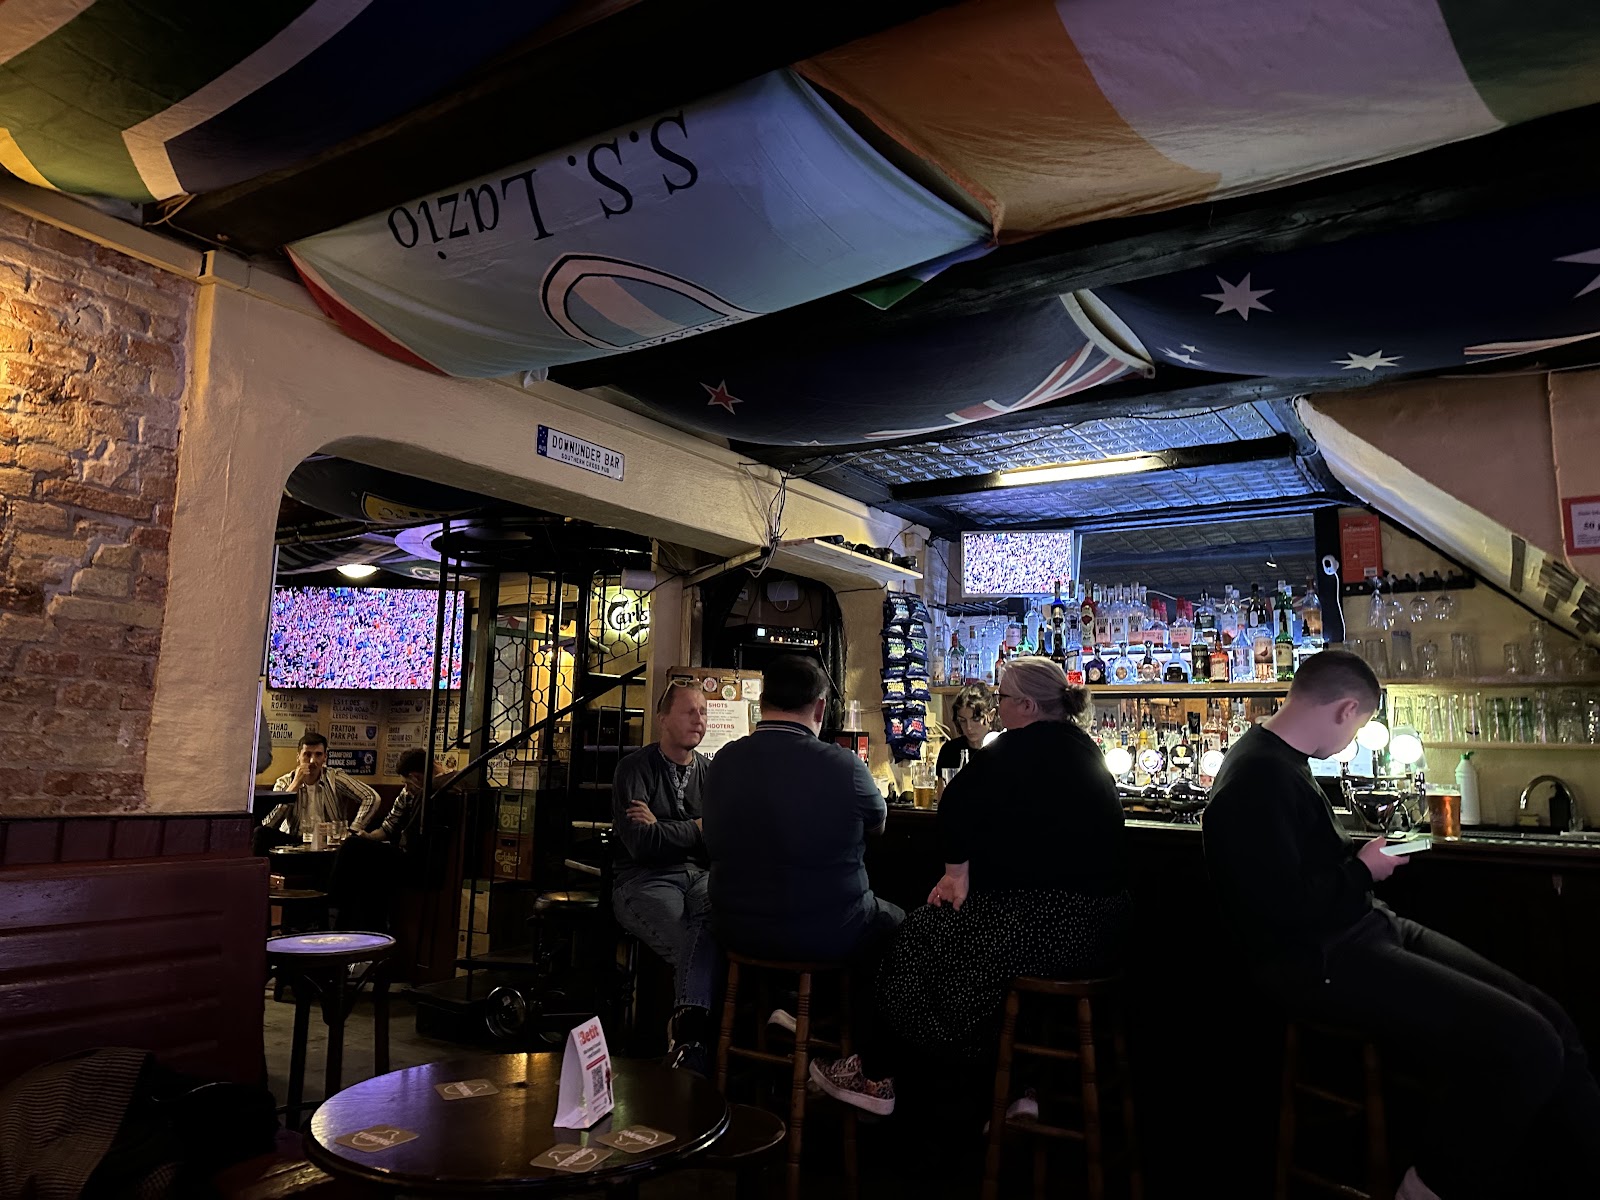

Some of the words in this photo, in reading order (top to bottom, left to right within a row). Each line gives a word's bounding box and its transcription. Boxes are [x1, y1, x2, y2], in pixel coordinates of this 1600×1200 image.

[566, 109, 700, 219] S.S.
[386, 167, 555, 260] Lazio
[552, 435, 601, 463] DOWNUNDER
[604, 453, 620, 469] BAR
[561, 452, 586, 466] SOUTHERN
[331, 724, 356, 732] FRATTON
